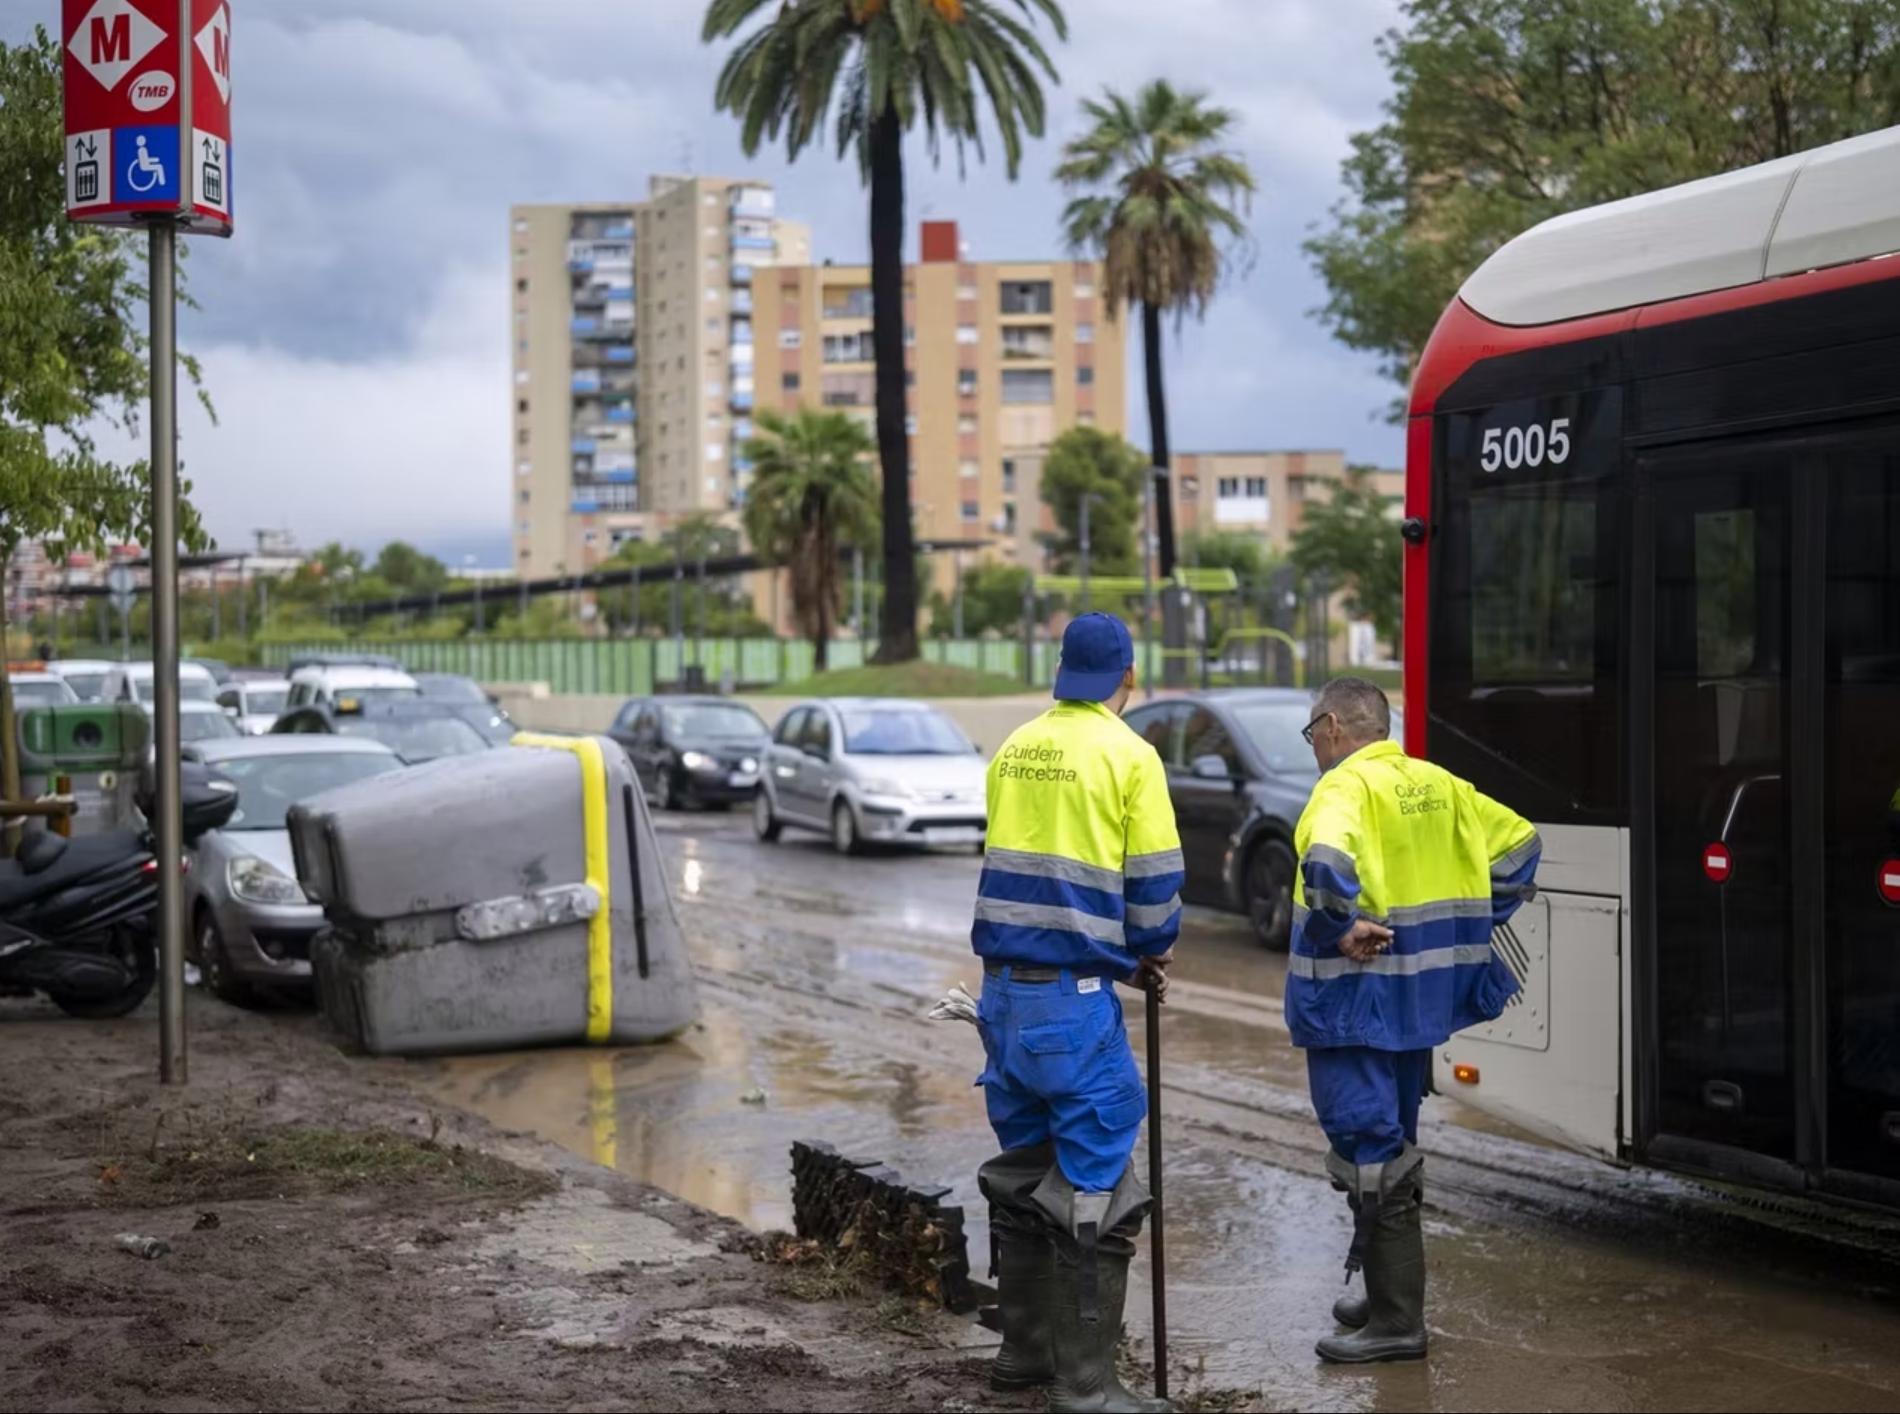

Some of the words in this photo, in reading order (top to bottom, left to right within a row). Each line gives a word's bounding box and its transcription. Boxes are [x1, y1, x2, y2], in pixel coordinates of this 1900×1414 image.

[91, 13, 130, 65] M
[138, 85, 169, 98] TMB
[1480, 418, 1571, 472] 5005
[1003, 743, 1064, 762] Cuidem
